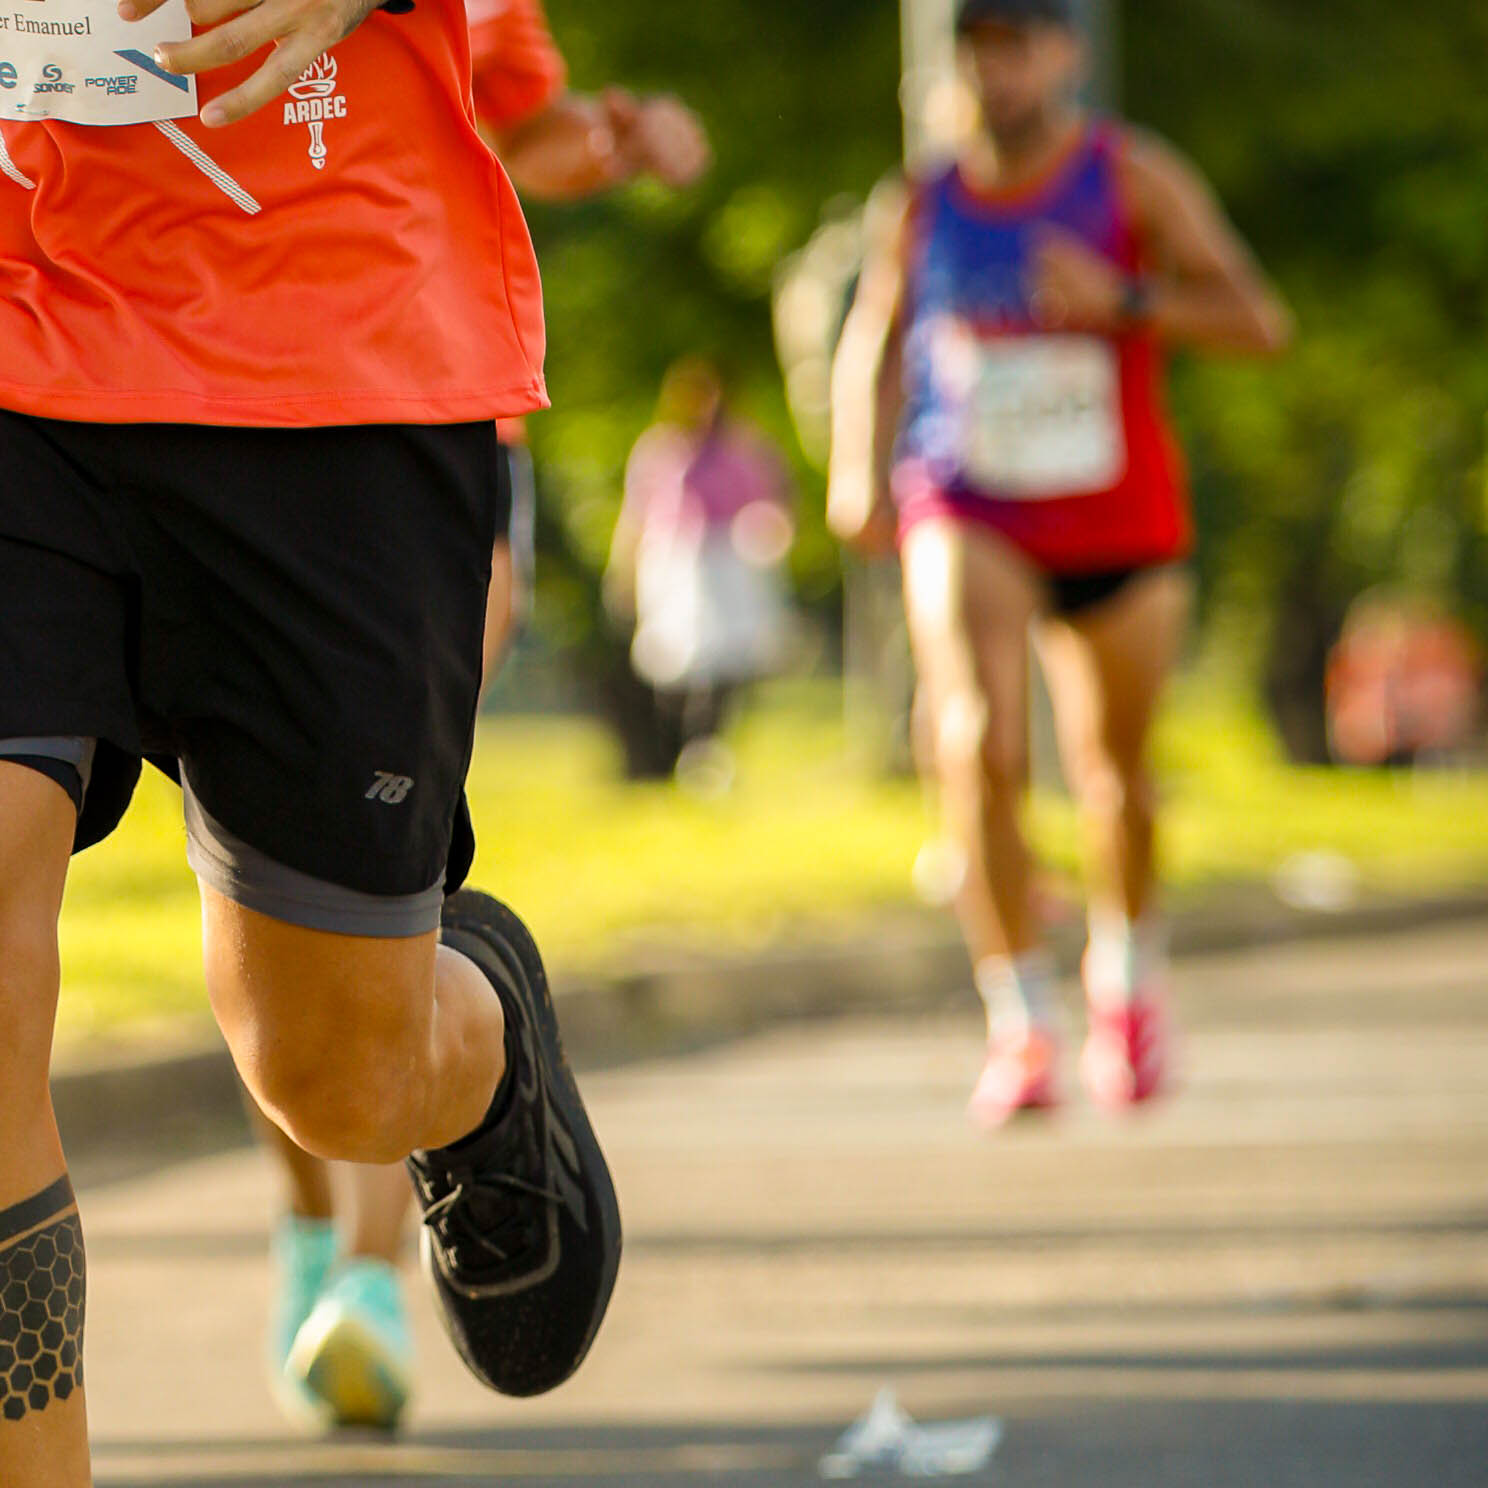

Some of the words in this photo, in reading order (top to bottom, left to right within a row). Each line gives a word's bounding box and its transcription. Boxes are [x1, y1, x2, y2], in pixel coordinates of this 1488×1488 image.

[14, 13, 91, 35] Emanuel
[85, 75, 138, 88] POWER
[283, 95, 347, 125] ARDEC
